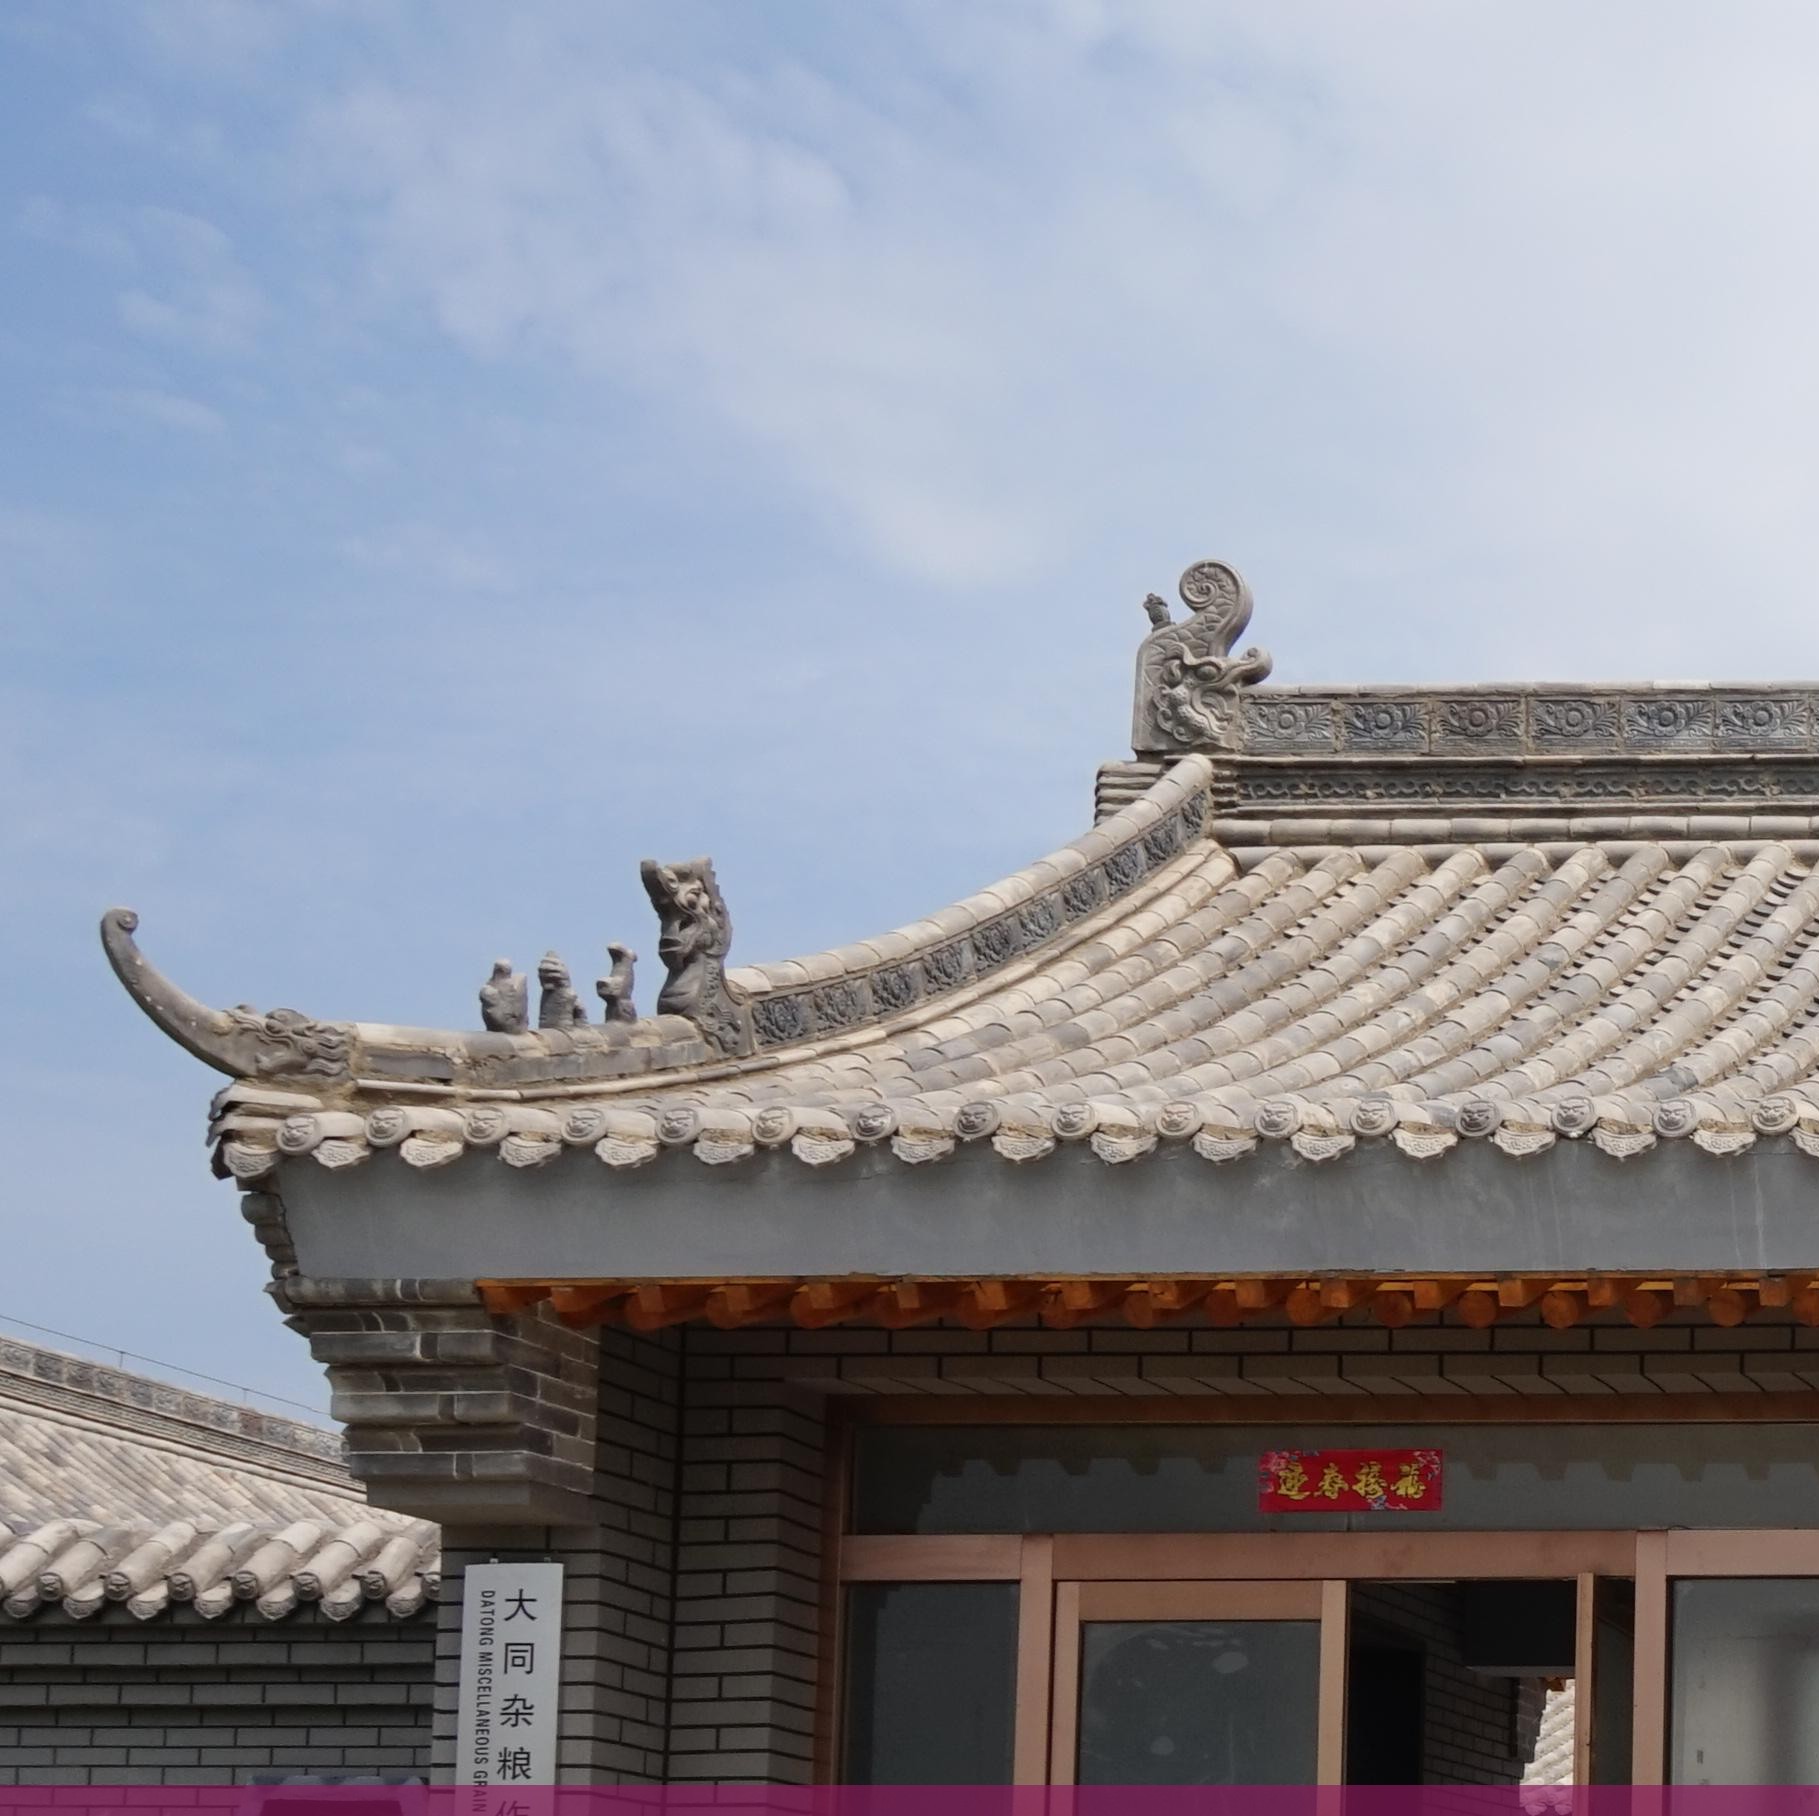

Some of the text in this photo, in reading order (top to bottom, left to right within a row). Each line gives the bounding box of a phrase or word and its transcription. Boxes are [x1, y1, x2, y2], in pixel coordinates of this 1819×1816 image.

[479, 1589, 496, 1646] DATONG
[474, 1651, 494, 1765] MISCELLANEOUS
[471, 1770, 489, 1812] GRAIN
